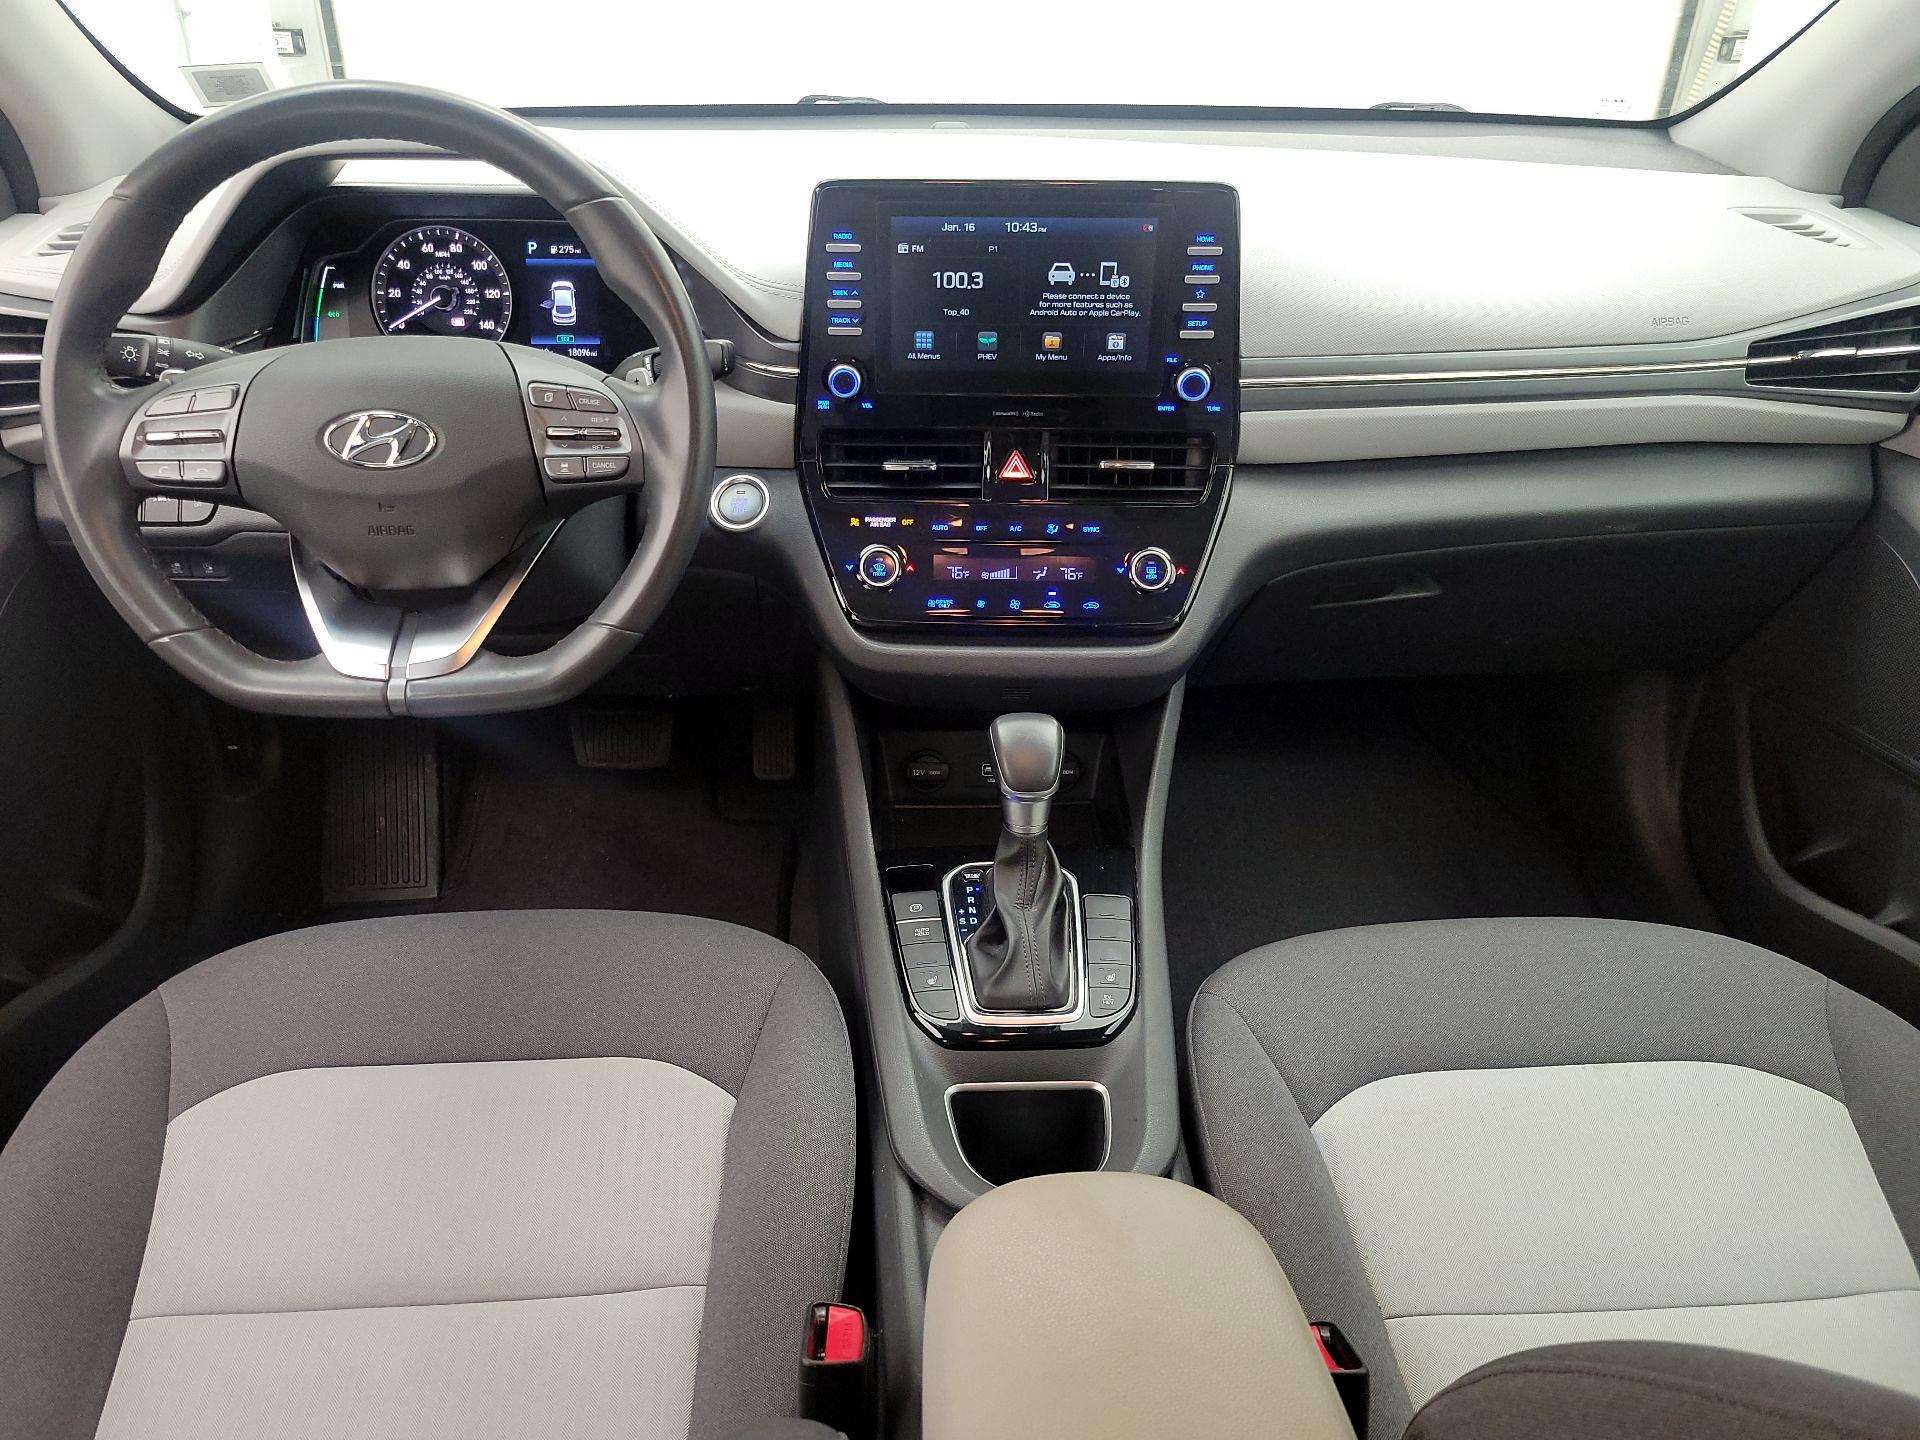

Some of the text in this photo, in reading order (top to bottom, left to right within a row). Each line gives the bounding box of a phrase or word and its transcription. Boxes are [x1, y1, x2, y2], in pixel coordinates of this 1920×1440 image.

[941, 223, 976, 232] Jan. 16
[422, 243, 434, 253] 60
[449, 243, 463, 253] 80
[527, 241, 538, 254] P
[911, 244, 924, 253] FM
[397, 259, 411, 270] 40
[471, 260, 488, 270] 100
[932, 271, 984, 289] 100.3
[388, 287, 401, 298] 20
[484, 288, 501, 299] 120
[1042, 292, 1067, 300] Please
[1105, 301, 1123, 309] such
[943, 308, 970, 317] Top_40
[1089, 310, 1110, 318] Apple
[1110, 310, 1142, 318] CarPlay.
[479, 319, 495, 330] 140
[1650, 316, 1690, 328] AIRBAG
[1035, 354, 1046, 362] My
[1097, 354, 1132, 362] Apps/Info
[578, 398, 601, 406] CRUISE
[367, 525, 415, 537] AIRBAG
[966, 886, 974, 894] P
[967, 896, 975, 904] R
[968, 906, 977, 914] N
[959, 917, 967, 925] S
[969, 917, 978, 925] D
